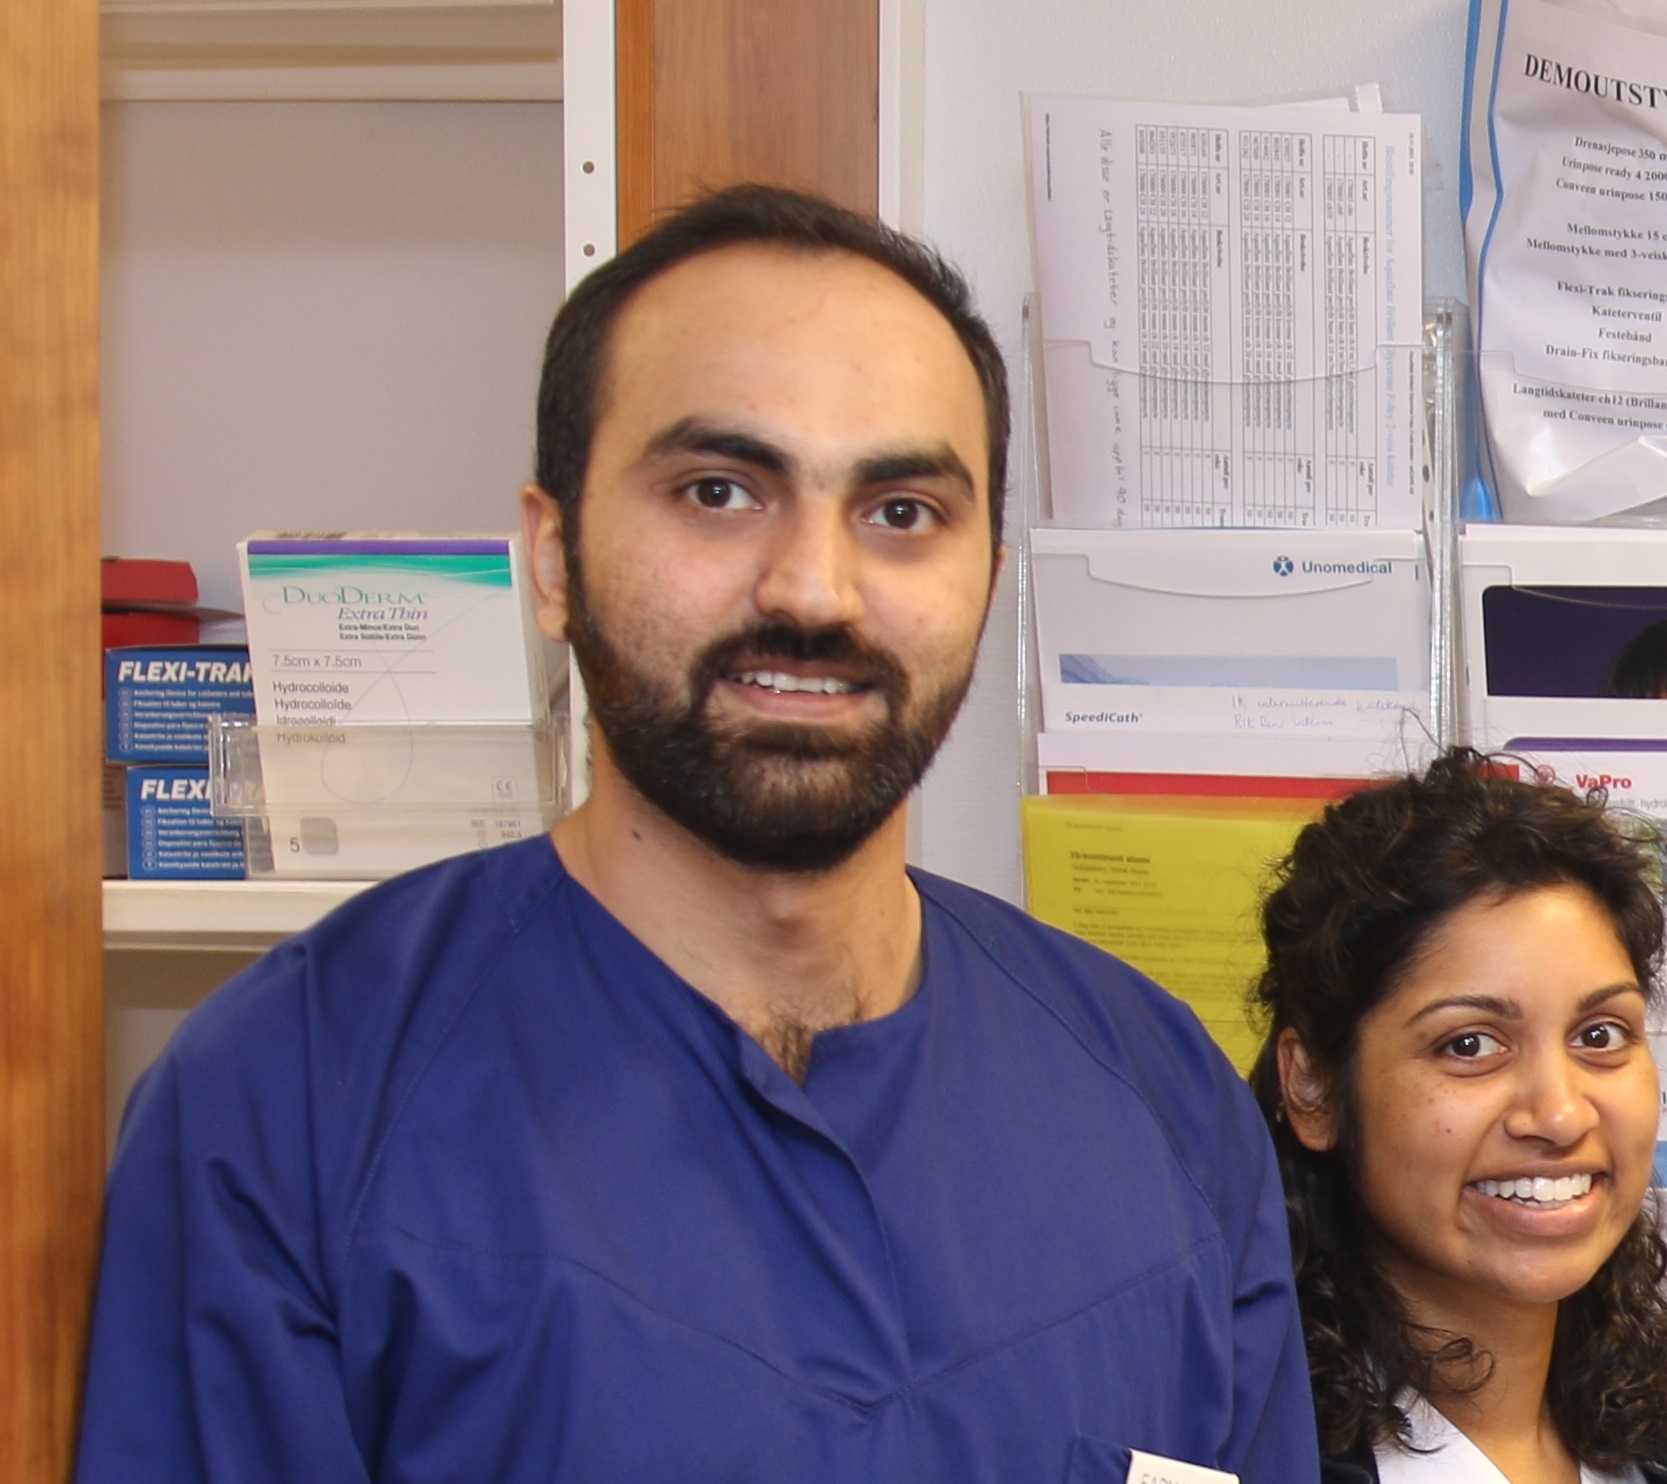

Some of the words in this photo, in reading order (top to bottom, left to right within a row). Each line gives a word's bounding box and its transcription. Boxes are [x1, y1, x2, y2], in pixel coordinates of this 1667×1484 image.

[1575, 136, 1636, 158] Drenasjepose
[1639, 148, 1655, 160] 350
[1562, 156, 1603, 173] Urinpose
[1605, 166, 1631, 180] ready
[1556, 178, 1596, 195] Conveen
[1599, 187, 1645, 201] urinpose
[1567, 223, 1643, 240] Mellomstykke
[1647, 231, 1659, 240] 15
[1527, 238, 1601, 256] Mellomstykke
[1604, 248, 1627, 258] med
[1557, 281, 1614, 297] Flexi-Trak
[1592, 306, 1662, 322] Kateterventil
[1598, 328, 1652, 342] Festebånd
[1546, 345, 1598, 360] Drain-Fix
[1513, 384, 1595, 402] Langtidskateter
[1599, 394, 1623, 405] ch12
[1543, 410, 1566, 419] med
[1570, 410, 1614, 425] Conveen
[1617, 417, 1663, 431] urinpose
[1302, 561, 1392, 574] Unomedical
[338, 607, 385, 620] Extra
[388, 607, 428, 621] Thin
[272, 655, 310, 667] 7.5cm
[314, 658, 320, 666] x
[324, 655, 362, 667] 7.5cm
[1065, 711, 1139, 724] SpeediCath
[1576, 774, 1632, 789] VaPro
[290, 837, 299, 852] 5
